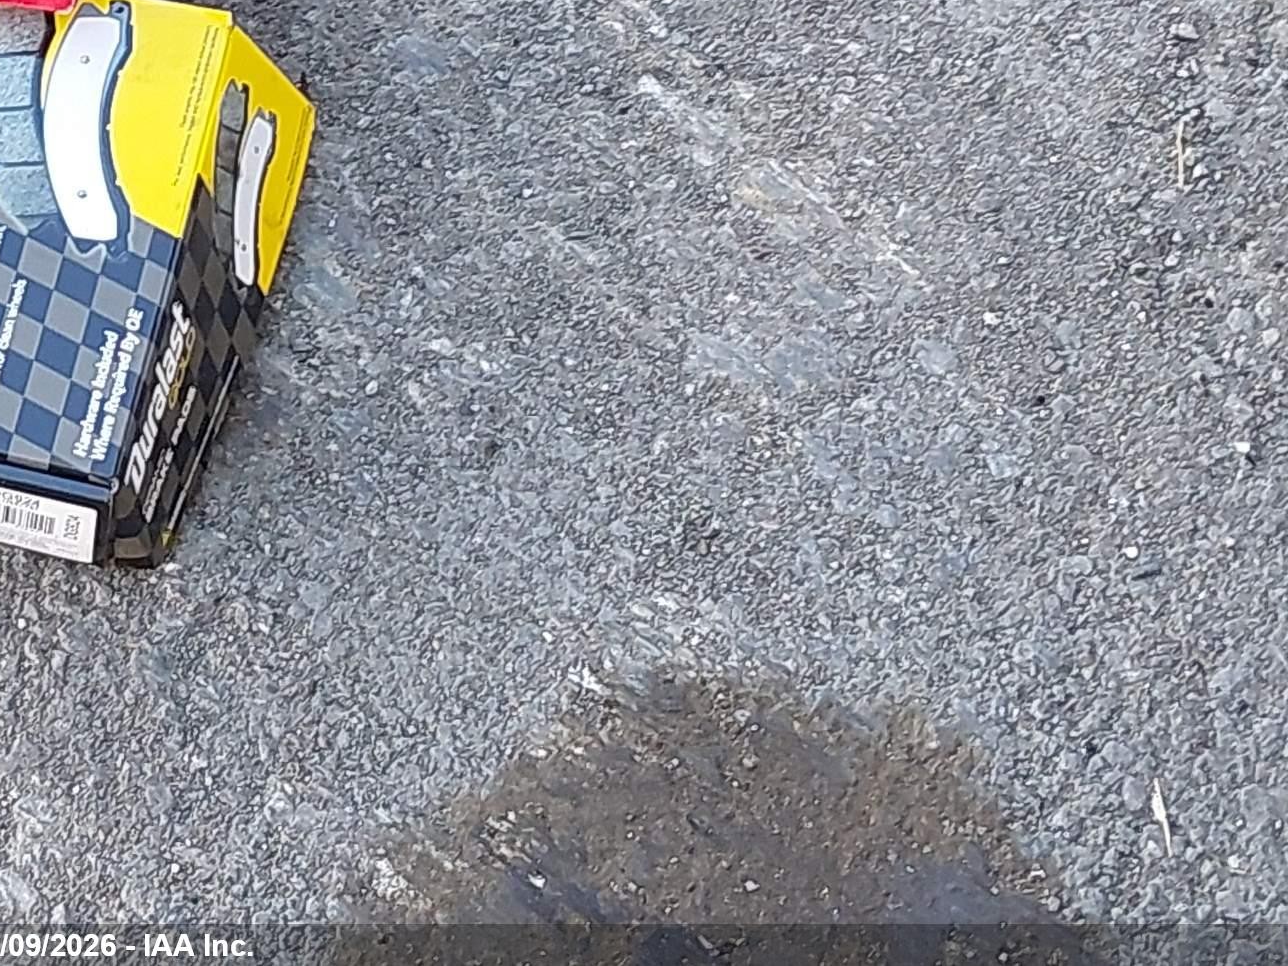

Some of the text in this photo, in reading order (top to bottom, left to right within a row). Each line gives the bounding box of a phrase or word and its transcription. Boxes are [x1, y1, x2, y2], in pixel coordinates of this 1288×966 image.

[6, 279, 28, 318] wheels
[73, 329, 119, 458] Hardware Included
[91, 307, 145, 461] Where Required By OE
[124, 300, 191, 495] Duralast
[144, 385, 197, 524] BRAKE PADS
